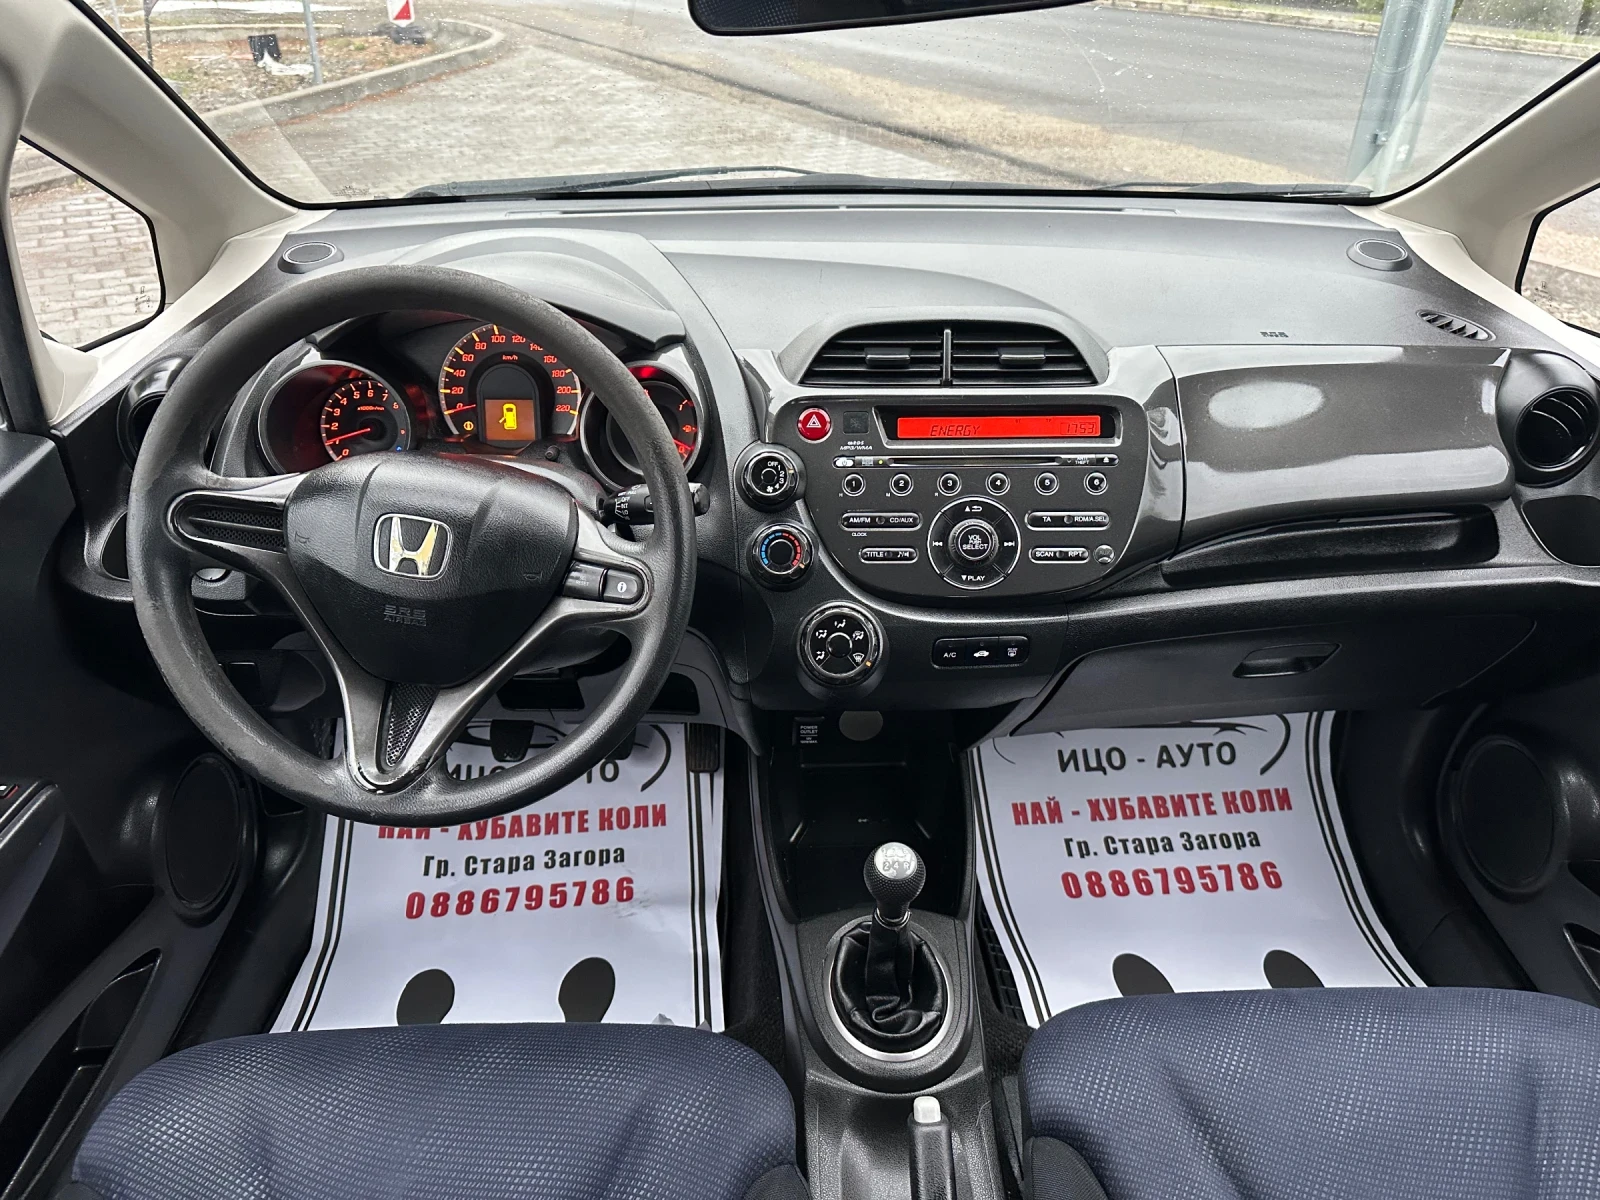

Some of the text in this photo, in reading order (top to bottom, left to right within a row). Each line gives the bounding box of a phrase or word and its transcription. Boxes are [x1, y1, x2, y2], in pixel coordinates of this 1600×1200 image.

[491, 335, 506, 343] 100
[462, 354, 474, 362] 60
[557, 386, 571, 394] 200
[353, 391, 360, 399] 5
[382, 393, 389, 401] 7
[340, 397, 347, 405] 4
[333, 408, 340, 416] 3
[556, 404, 570, 412] 220
[330, 422, 339, 430] 2
[930, 424, 980, 437] ENERGY
[384, 604, 427, 618] SRS
[1057, 746, 1126, 775] ИЦО
[1156, 741, 1236, 769] АУТО
[1011, 796, 1064, 826] НАЙ
[1087, 791, 1217, 822] ХУБАВИТЕ
[1222, 787, 1293, 815] КОЛИ
[457, 809, 589, 841] ХУБАВИТЕ
[598, 803, 667, 831] КОЛИ
[1064, 830, 1261, 859] Гр. Стара Загора
[423, 847, 625, 879] Гр. Стара Загора
[883, 862, 890, 870] 2
[1061, 861, 1283, 899] 0886795786
[406, 876, 634, 919] 0886795786
